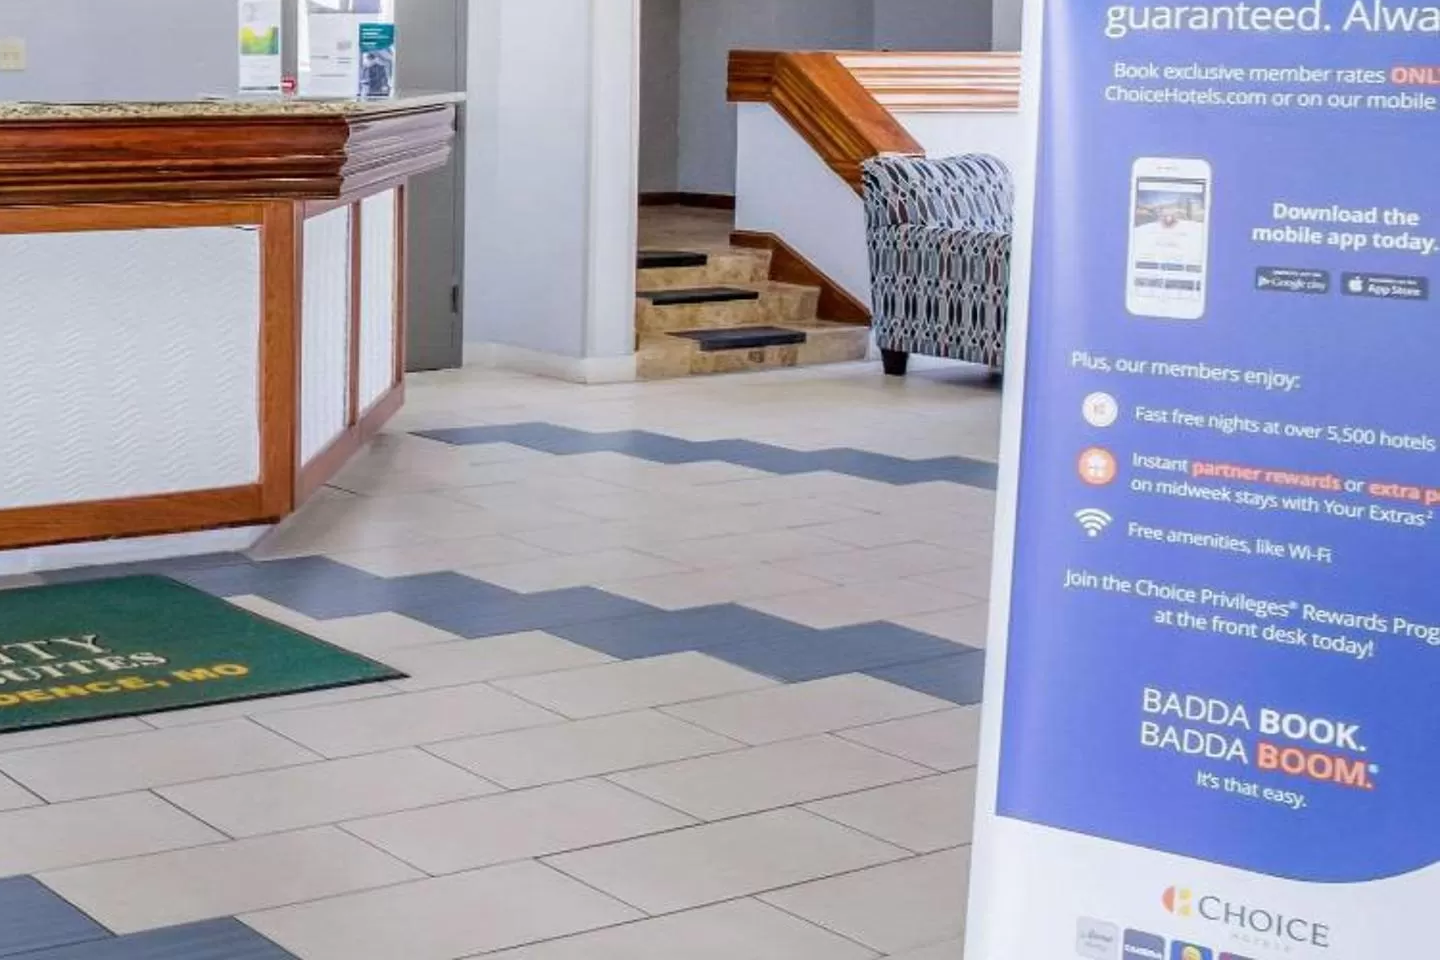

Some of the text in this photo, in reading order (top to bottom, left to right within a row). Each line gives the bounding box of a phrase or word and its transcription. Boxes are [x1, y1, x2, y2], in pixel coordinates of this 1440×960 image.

[1114, 62, 1440, 85] Book exclusive member rates ONL
[1104, 85, 1437, 110] ChoiceHotels.com or on our mobile
[1272, 202, 1421, 226] Download the
[1251, 226, 1440, 255] mobile app today.
[1072, 351, 1301, 392] Plus, our members enjoy:
[1135, 406, 1436, 452] Fast free nights at over 5,500 hotels
[1131, 478, 1153, 493] on
[1156, 477, 1231, 503] midweek
[1235, 488, 1278, 510] stays
[1282, 496, 1320, 513] with
[1324, 499, 1364, 518] Your
[1132, 452, 1189, 472] Instant
[1192, 459, 1261, 482] partner
[1264, 467, 1342, 491] rewards
[1344, 478, 1366, 493] or
[1368, 481, 1420, 501] extra
[1128, 521, 1332, 564] Free amenities, like Wi-Fi
[1064, 569, 1098, 589] Join
[1101, 573, 1132, 594] the
[1135, 578, 1196, 603] Choice
[1302, 604, 1388, 632] Rewards
[1393, 617, 1440, 646] Prog
[1155, 607, 1374, 659] at the front desk today!
[174, 662, 251, 684] MO
[1143, 687, 1367, 752] BADDA BOOK.
[1140, 721, 1248, 765] BADDA
[1197, 770, 1307, 810] It's that easy.
[1198, 895, 1330, 948] CHOICE
